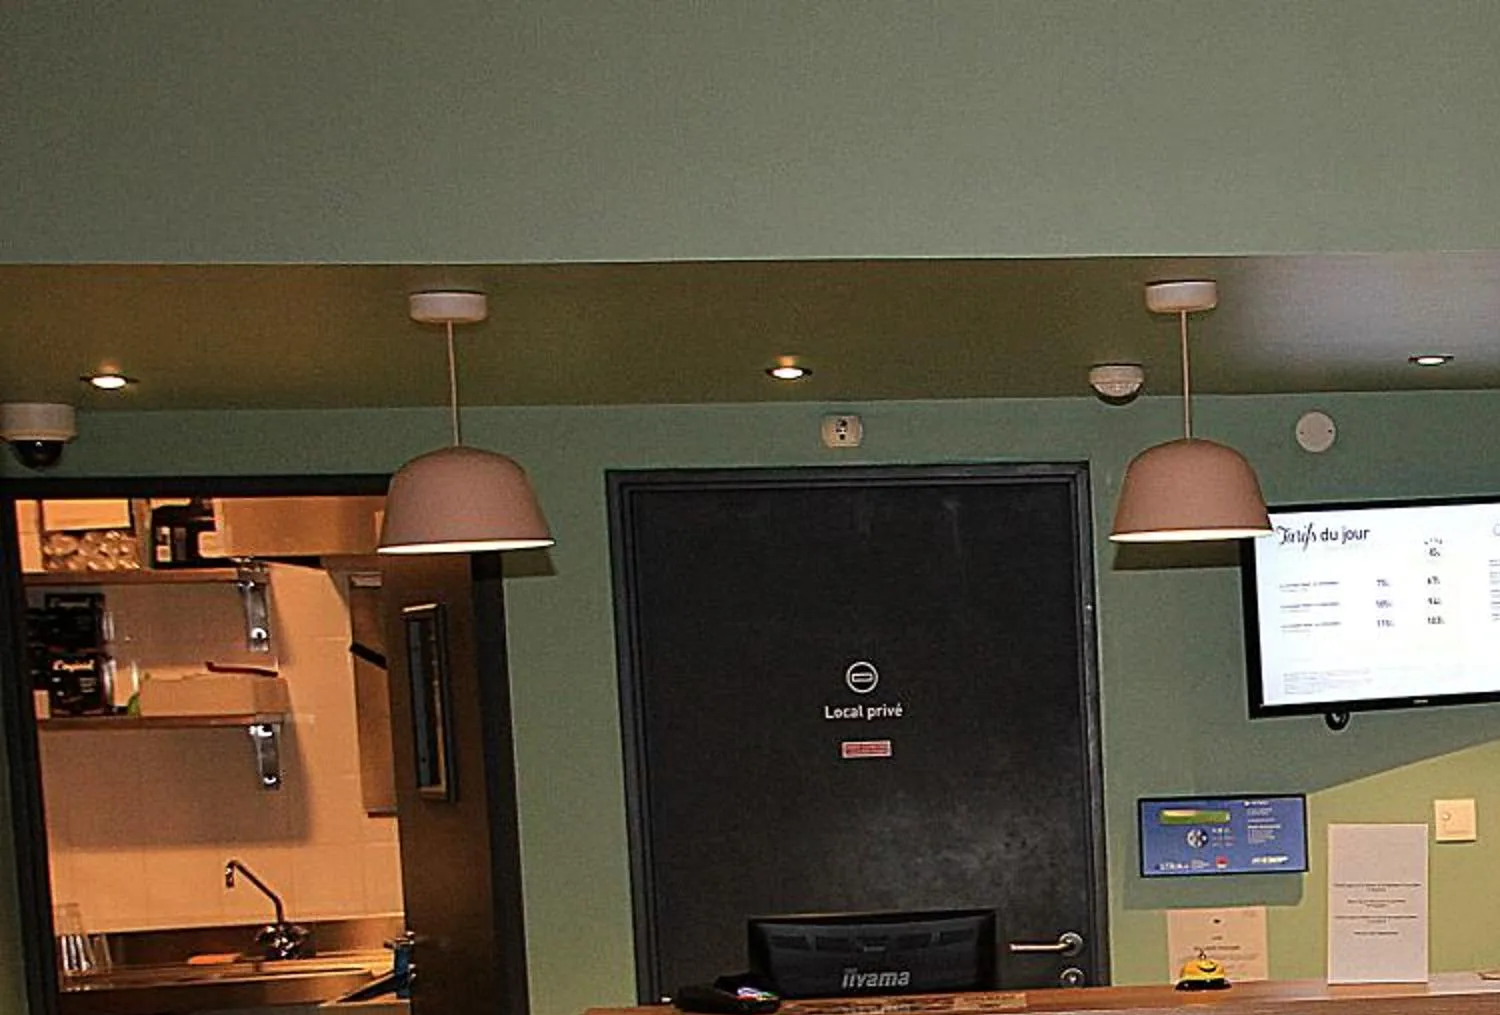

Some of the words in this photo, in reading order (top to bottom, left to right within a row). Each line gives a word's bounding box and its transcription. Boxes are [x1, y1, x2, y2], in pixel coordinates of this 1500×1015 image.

[1320, 527, 1339, 541] du
[1341, 525, 1371, 545] jour
[824, 704, 864, 719] Local
[867, 702, 904, 721] privé
[841, 967, 911, 989] iiyama
